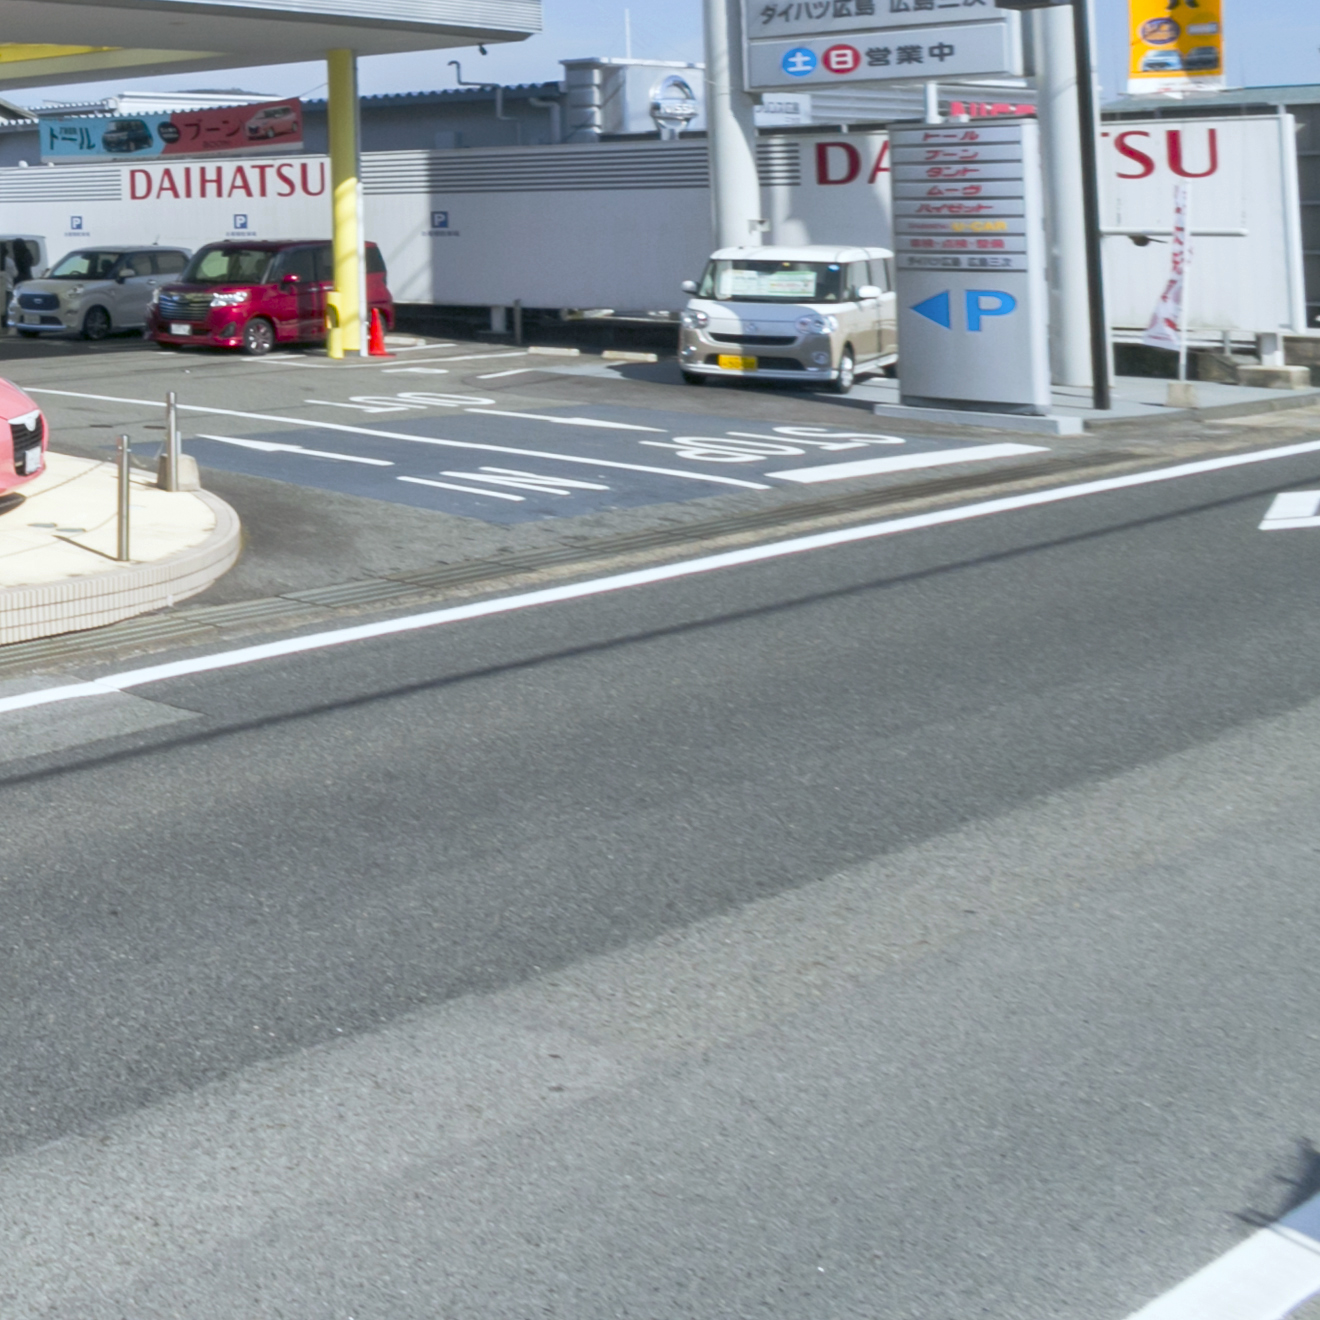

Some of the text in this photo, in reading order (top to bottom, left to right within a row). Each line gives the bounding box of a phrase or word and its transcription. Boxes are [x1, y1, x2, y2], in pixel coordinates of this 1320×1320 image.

[128, 161, 327, 200] DAIHATSU
[235, 215, 246, 227] P
[964, 289, 1017, 332] P
[637, 426, 907, 463] STOP
[396, 465, 611, 502] IN
